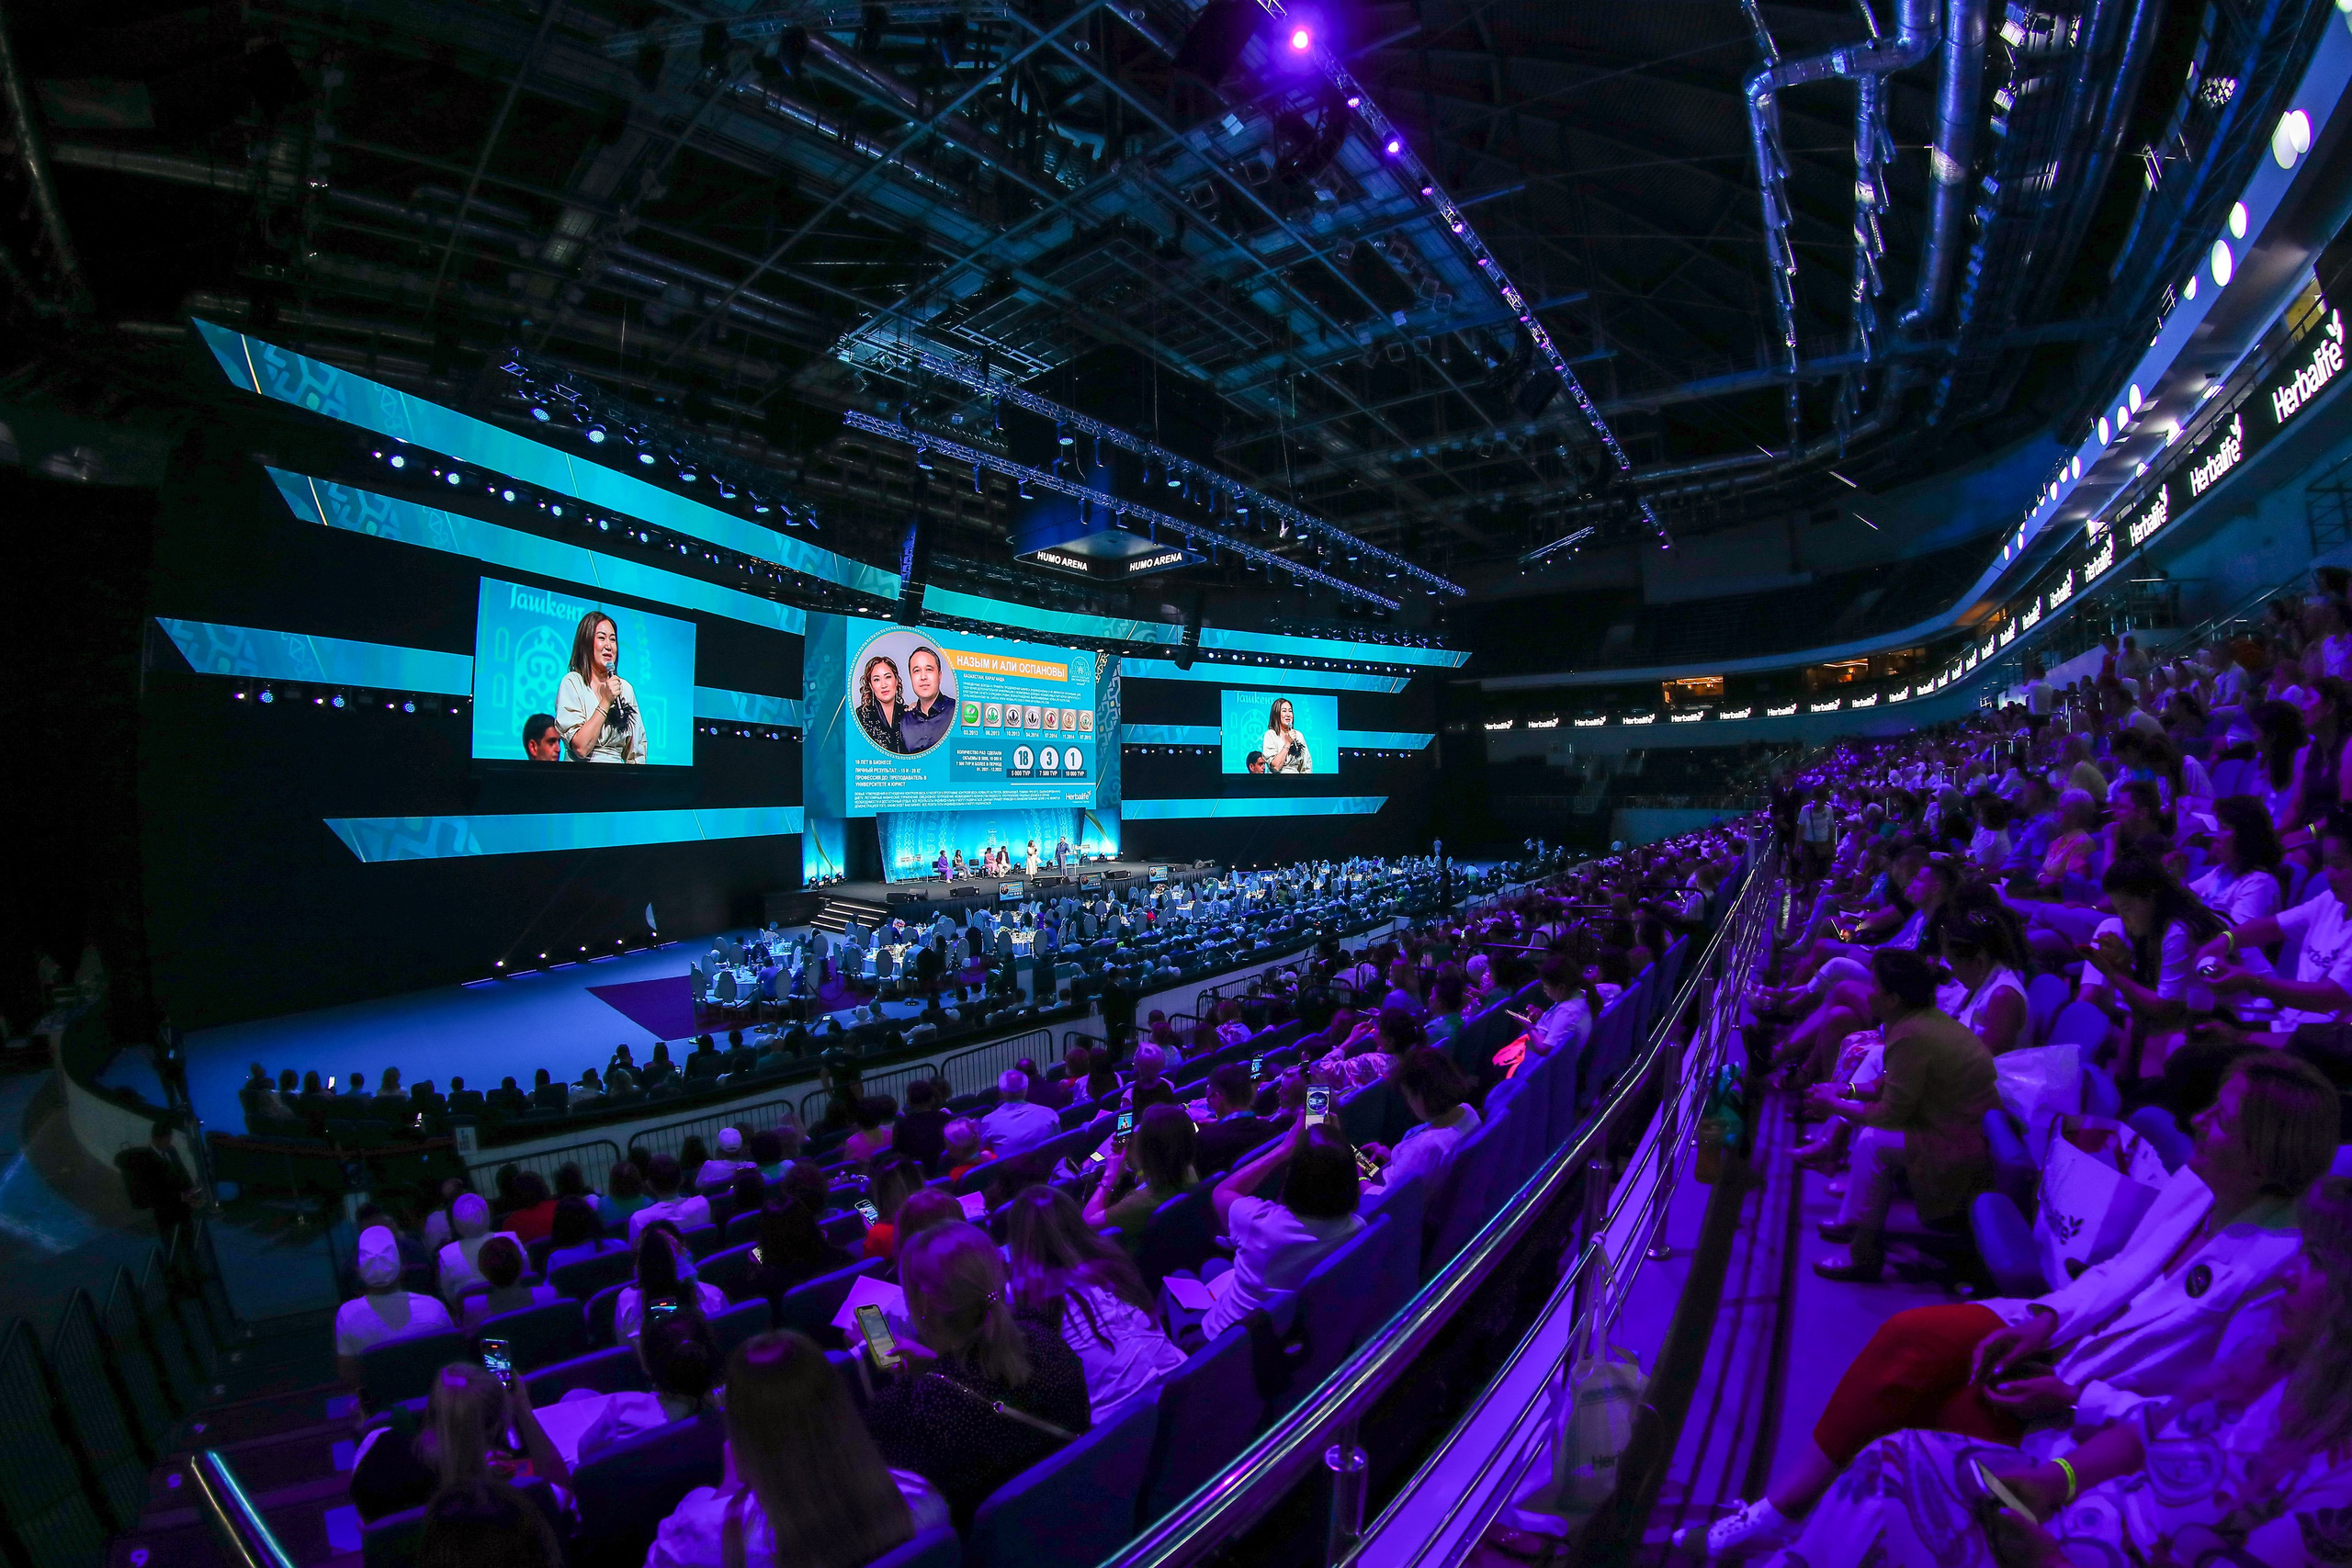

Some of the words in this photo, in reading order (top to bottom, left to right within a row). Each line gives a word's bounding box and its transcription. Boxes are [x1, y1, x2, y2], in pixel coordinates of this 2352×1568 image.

[2271, 338, 2345, 424] Herbalife
[2188, 435, 2243, 497] Herbalife
[2129, 501, 2168, 547] Herbalife
[1036, 550, 1061, 565] HUMO
[1062, 557, 1088, 571] ARENA
[1129, 558, 1154, 572] HUMO
[1154, 552, 1182, 567] ARENA
[956, 655, 990, 670] НАЗЫМ
[991, 660, 999, 671] И
[1000, 662, 1018, 672] АЛИ
[1019, 665, 1065, 678] ОСПАНОВЫ
[1719, 710, 1749, 720] Herbalife
[1767, 705, 1796, 716] Herbalife
[1810, 702, 1838, 713] Herbalife
[1528, 719, 1556, 728] Herbalife
[1574, 717, 1604, 727] Herbalife
[1623, 716, 1653, 726] Herbalife
[1670, 714, 1702, 723] Herbalife
[1018, 750, 1029, 766] 18
[1046, 750, 1052, 766] 3
[1070, 751, 1075, 767] 1
[1065, 791, 1091, 801] Herbalife
